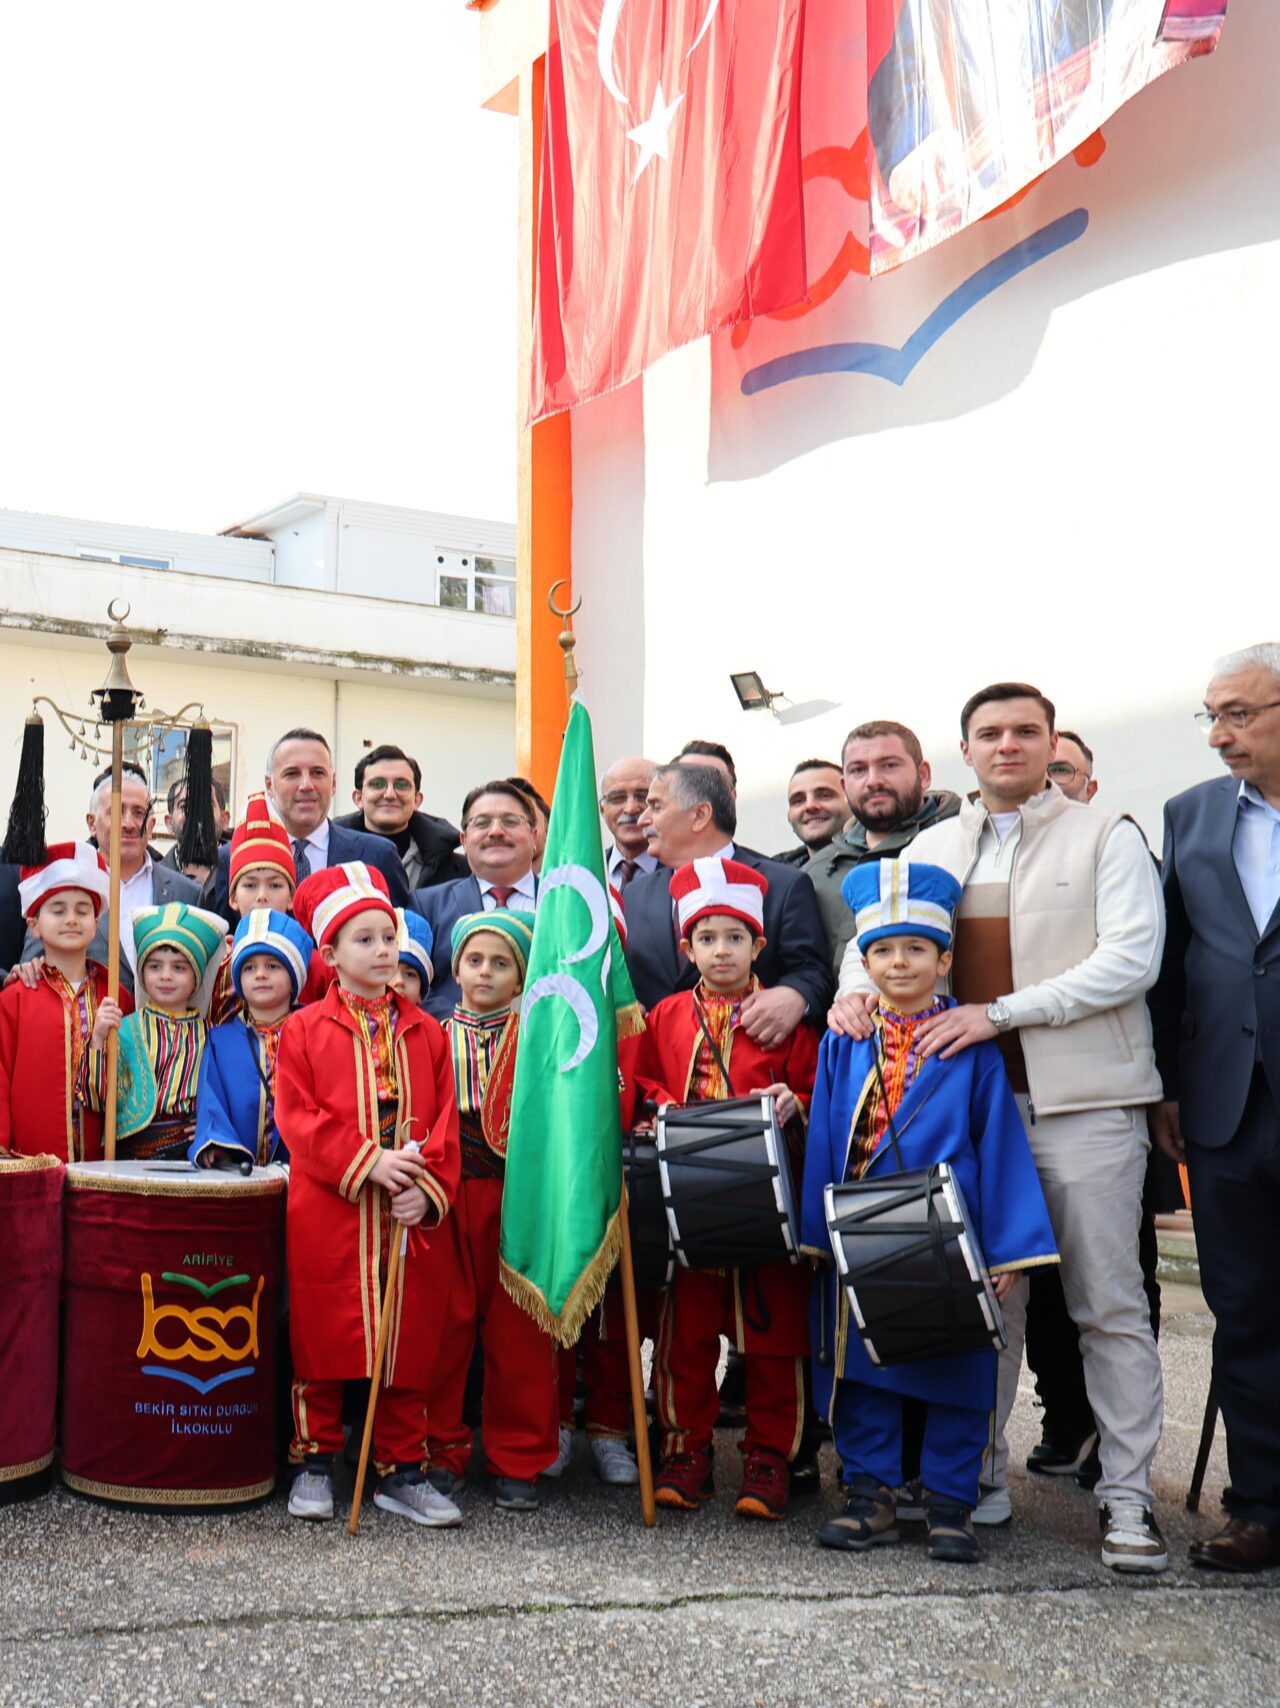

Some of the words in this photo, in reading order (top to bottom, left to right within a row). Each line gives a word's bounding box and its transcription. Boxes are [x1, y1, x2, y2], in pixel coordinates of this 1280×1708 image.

[182, 1251, 234, 1266] ARİFİYE
[135, 1401, 175, 1416] BEKİR
[180, 1404, 212, 1417] SITKI
[216, 1402, 258, 1416] DURGUN
[171, 1418, 233, 1435] İLKOKULU
